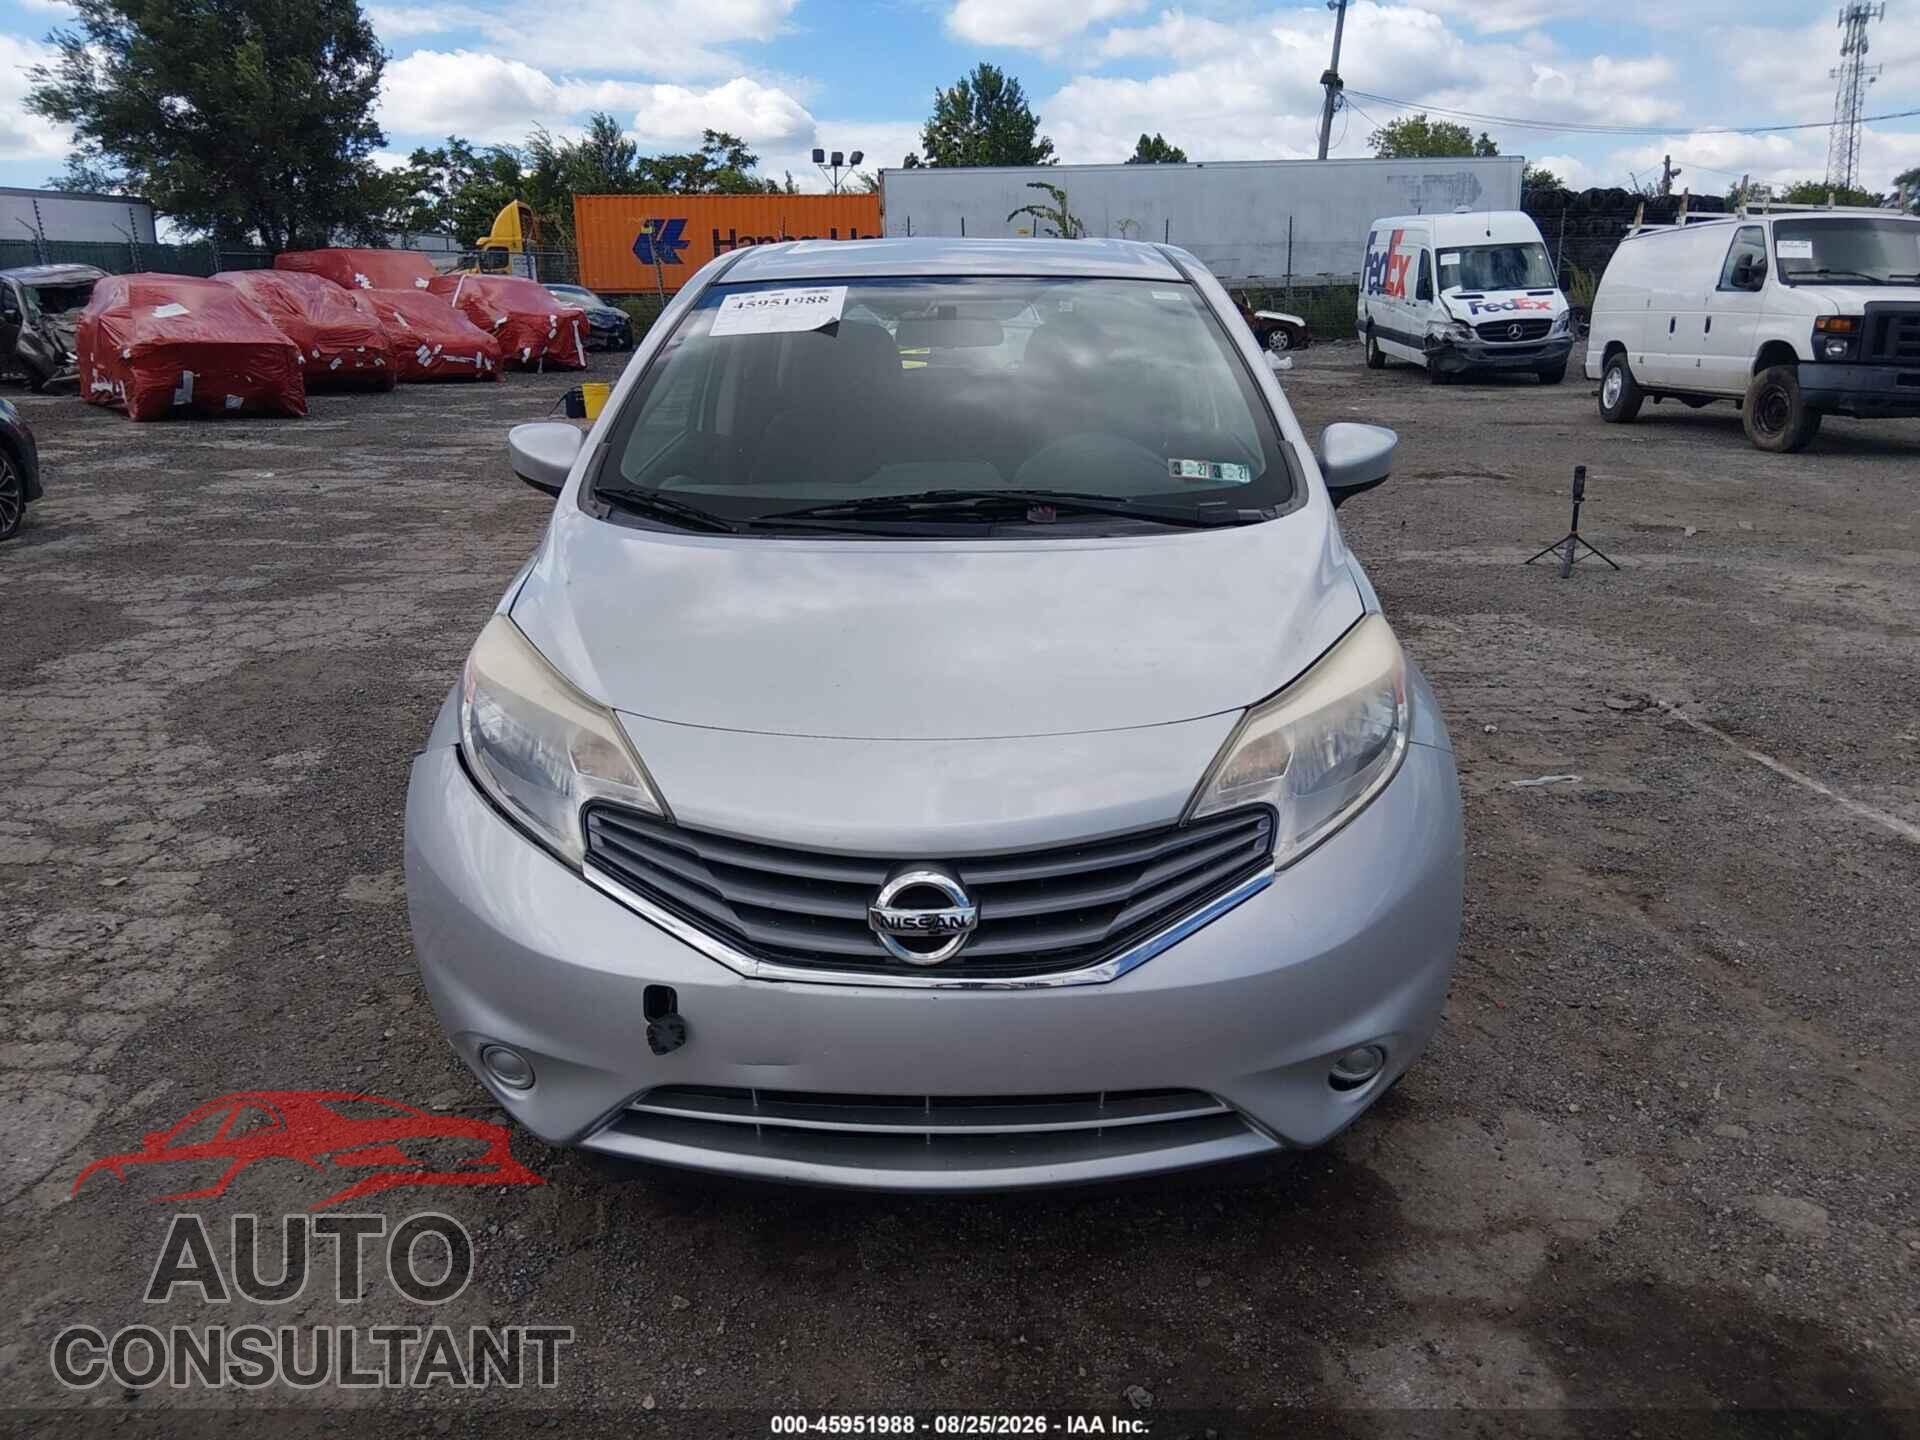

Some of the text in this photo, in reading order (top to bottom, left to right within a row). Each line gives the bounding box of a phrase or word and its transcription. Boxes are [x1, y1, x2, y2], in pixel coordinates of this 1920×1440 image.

[1360, 229, 1412, 299] FedEx
[1467, 297, 1553, 316] FedEx
[879, 913, 967, 931] NISSAN
